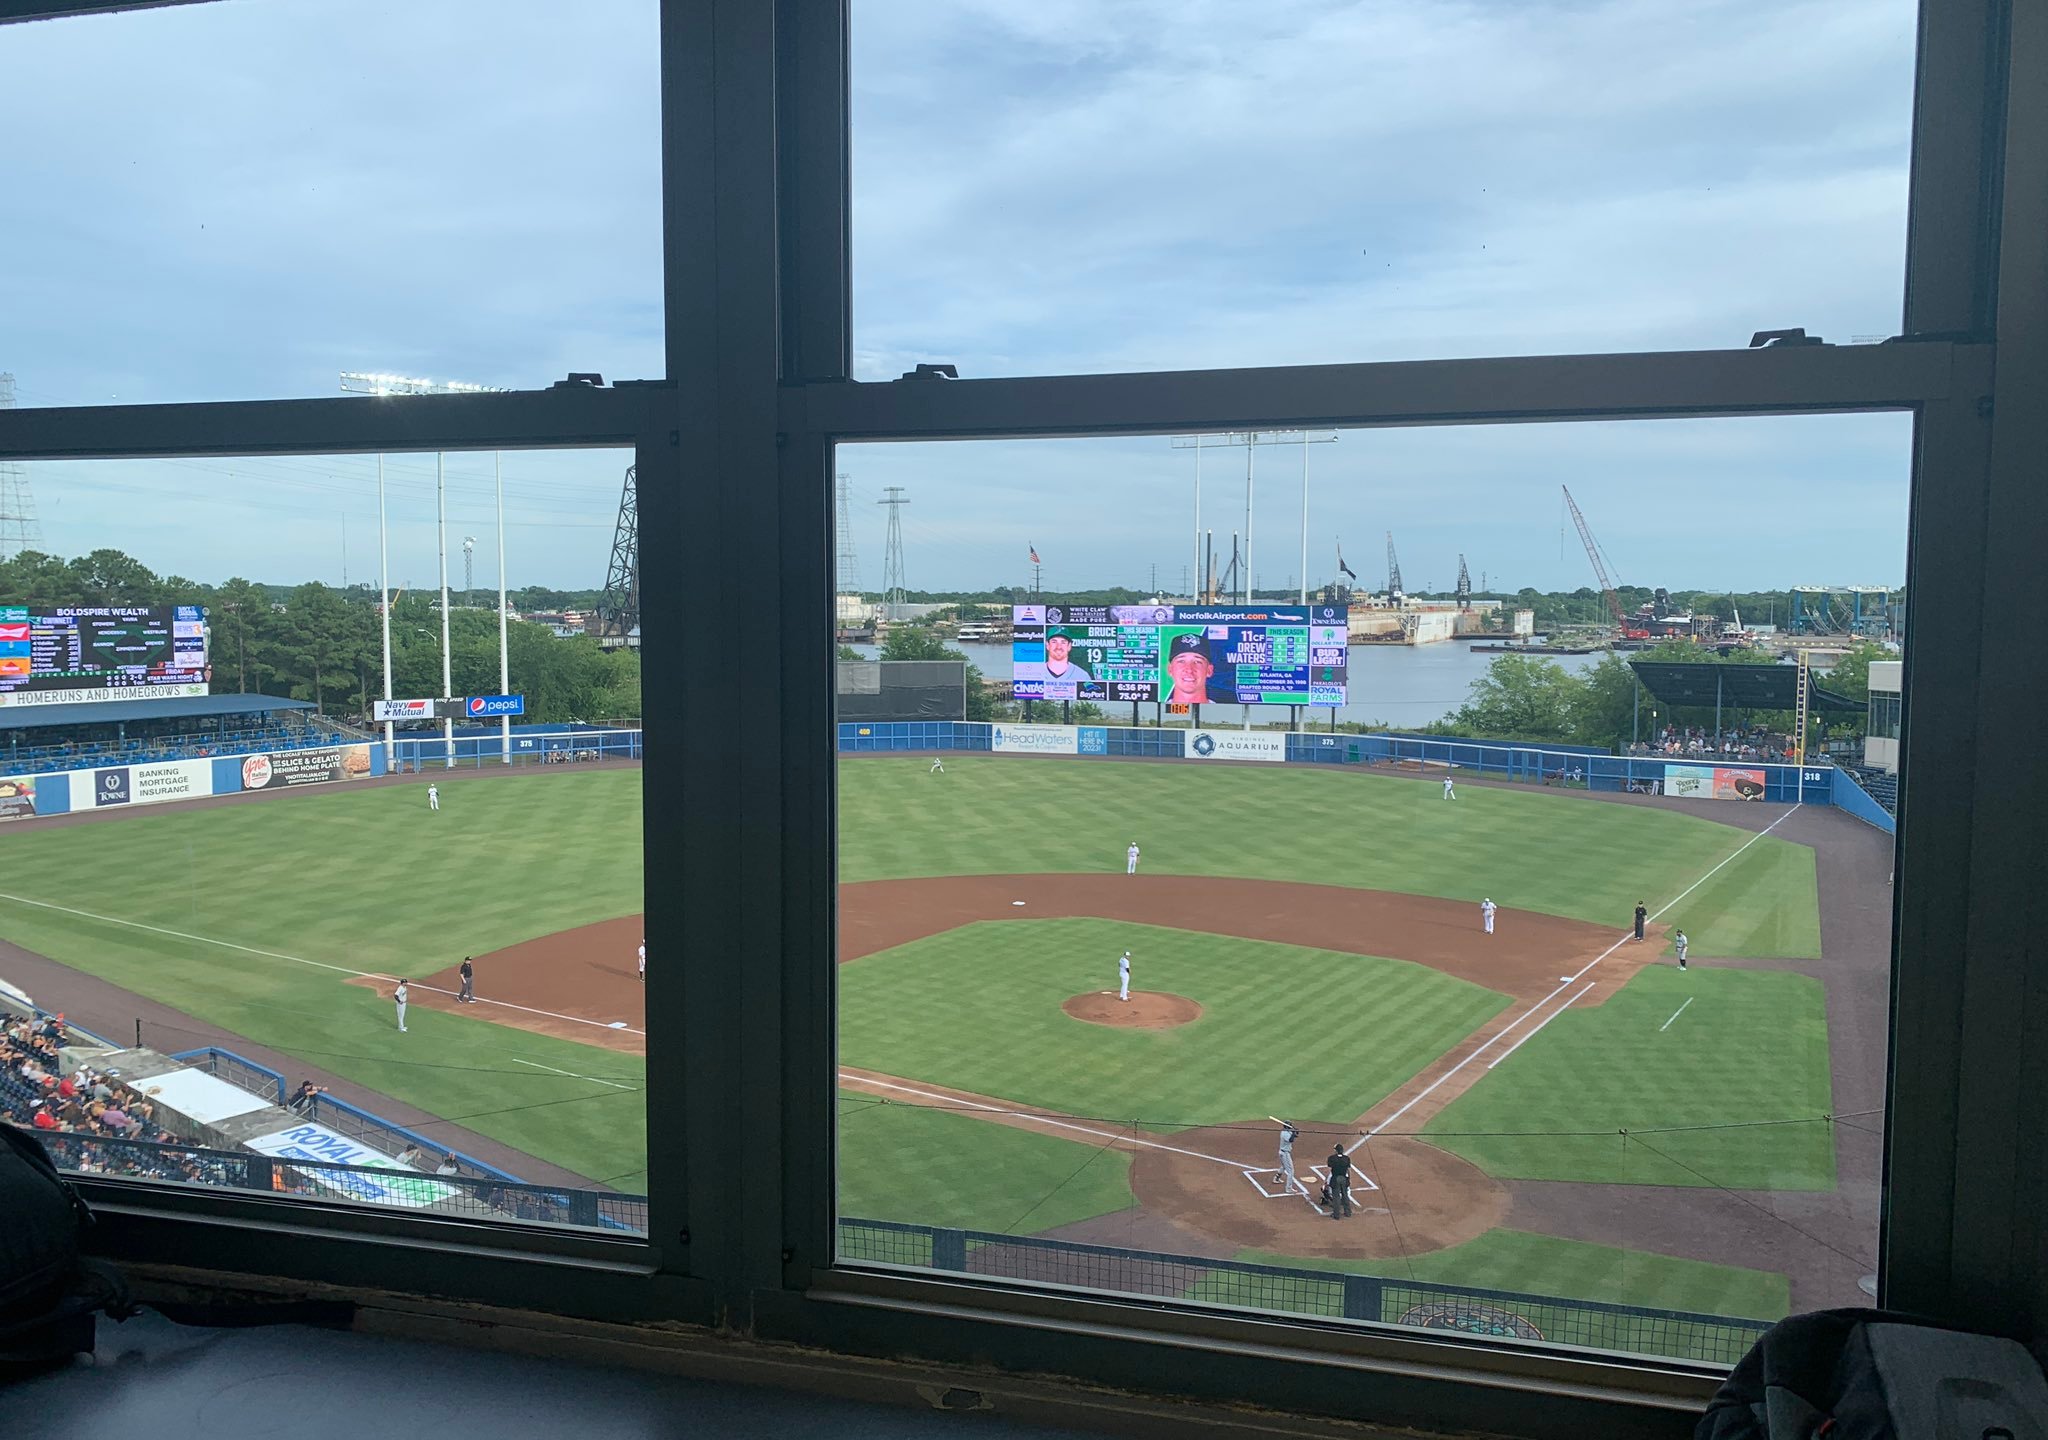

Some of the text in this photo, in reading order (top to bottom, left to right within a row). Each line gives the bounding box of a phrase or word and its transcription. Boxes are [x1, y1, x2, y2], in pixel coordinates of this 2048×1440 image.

[1179, 612, 1268, 621] NorfolkAirport.com
[1014, 632, 1044, 640] Smithfield
[1088, 627, 1116, 636] BRUCE
[1238, 643, 1266, 653] DREW
[1087, 648, 1102, 662] 19
[1226, 653, 1265, 663] WATERS
[17, 690, 82, 704] HOMERUNS
[87, 688, 109, 700] AND
[114, 686, 180, 699] HOMEGROWS
[385, 702, 408, 710] Navy
[488, 699, 518, 712] pepsi
[1004, 733, 1073, 745] HeadWaters
[281, 759, 303, 767] SLICE
[312, 755, 340, 764] GELATO
[139, 768, 178, 777] BANKING
[1804, 773, 1821, 781] 318
[139, 776, 188, 786] MORTGAGE
[140, 785, 189, 796] INSURANCE
[99, 791, 127, 801] TOWNE
[280, 1126, 362, 1164] ROYAL
